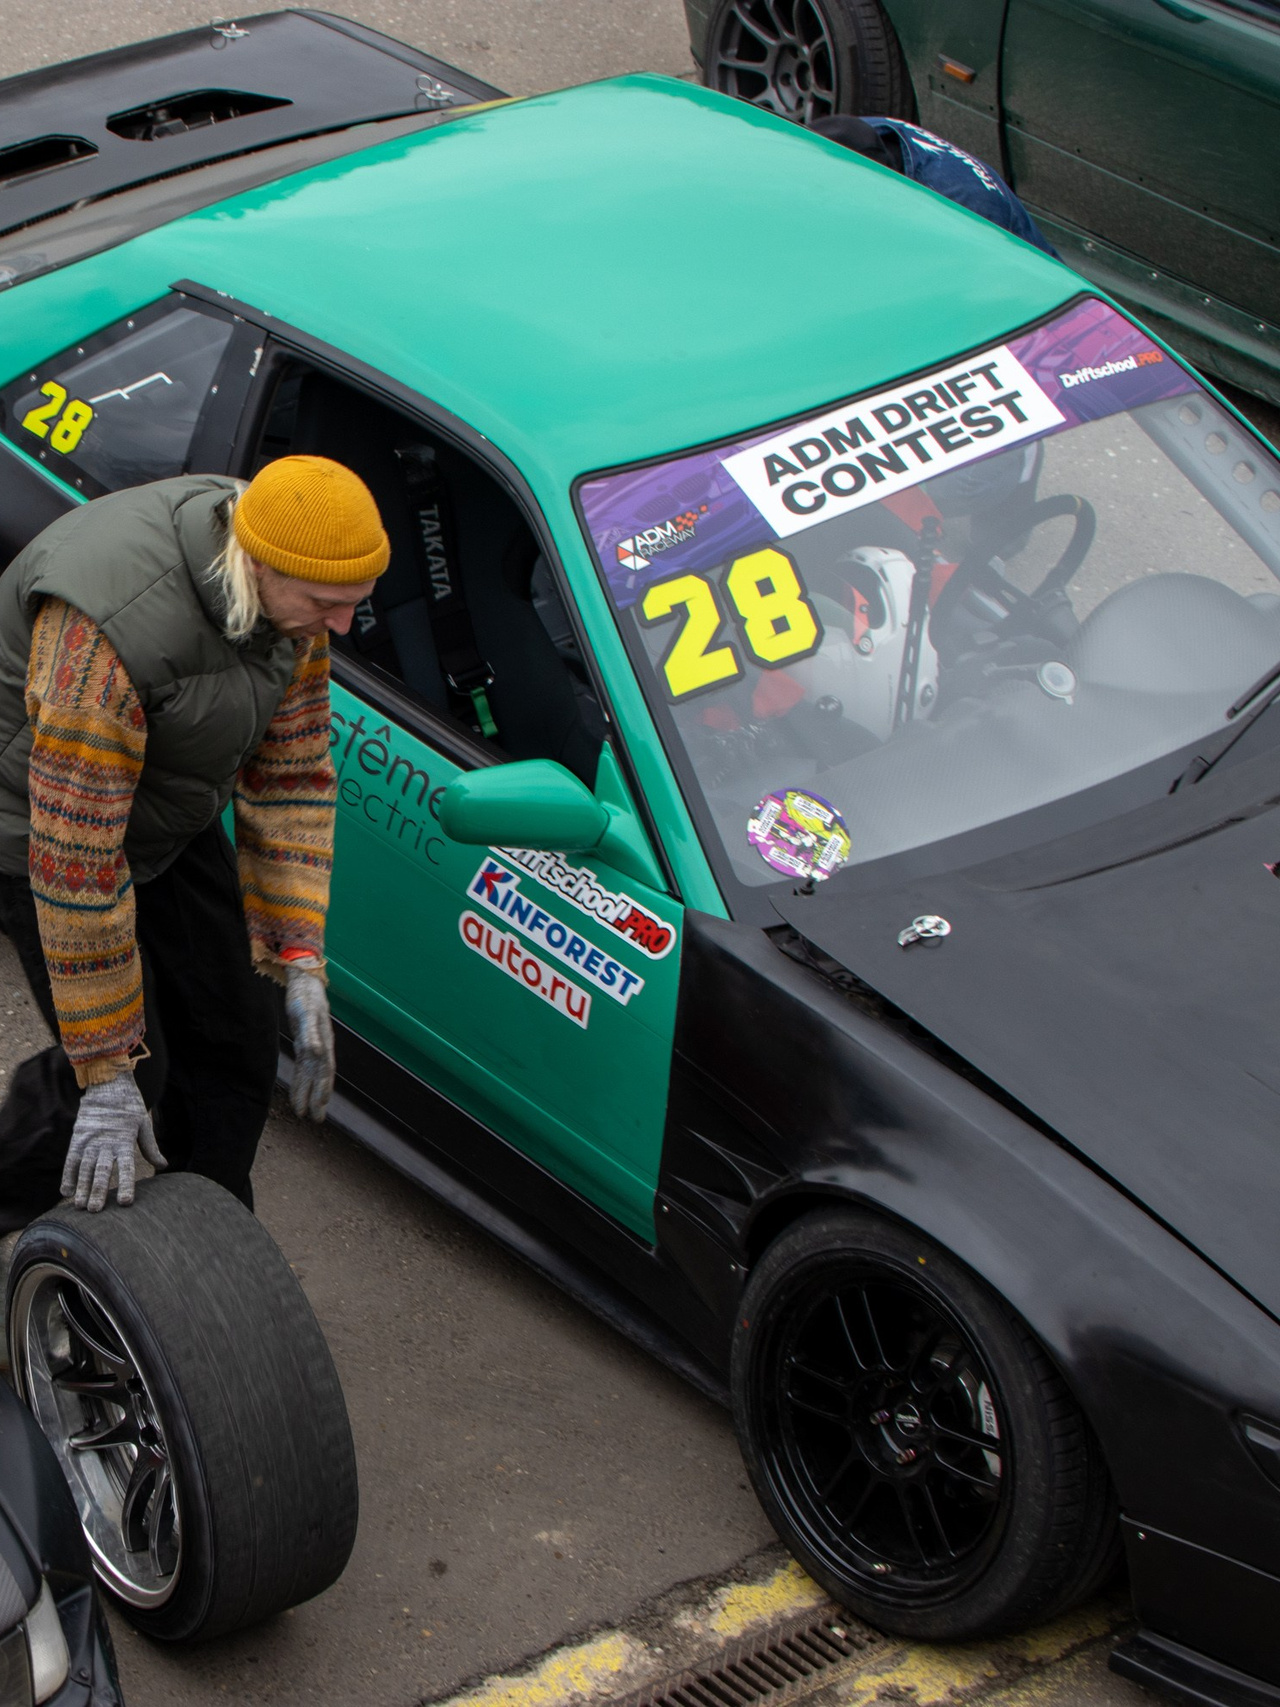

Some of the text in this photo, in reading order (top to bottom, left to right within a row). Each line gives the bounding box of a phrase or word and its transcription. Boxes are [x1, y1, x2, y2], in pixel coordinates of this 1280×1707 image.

[21, 381, 94, 455] 28
[1059, 351, 1164, 388] Driftschool.PRO
[763, 361, 1004, 487] ADM DRIFT
[781, 390, 1029, 515] CONTEST
[419, 503, 453, 601] TAKATA
[634, 520, 678, 550] ADM
[639, 526, 696, 559] RACEWAY
[641, 547, 819, 698] 28
[337, 760, 447, 866] lectric
[462, 915, 587, 1023] auto.ru
[472, 860, 640, 998] KINFOREST
